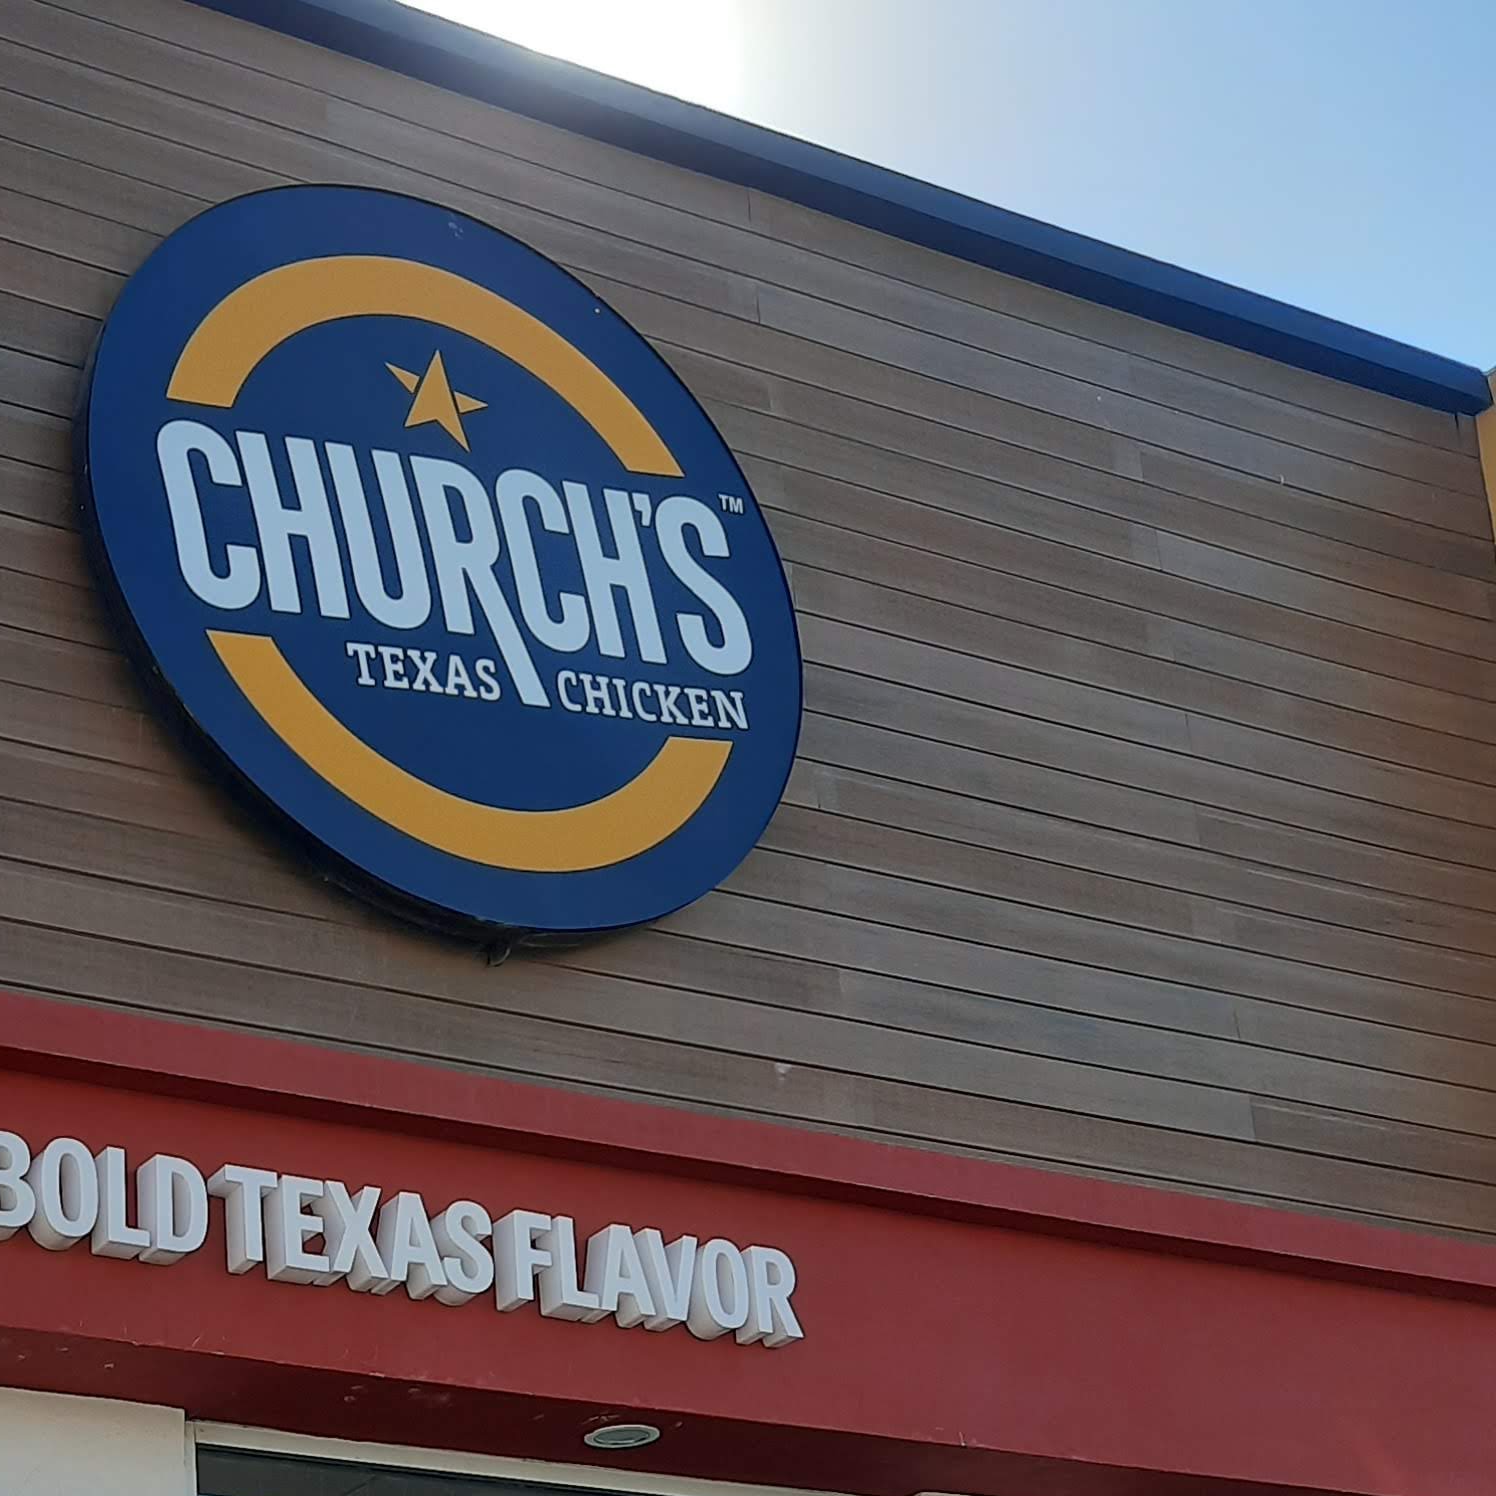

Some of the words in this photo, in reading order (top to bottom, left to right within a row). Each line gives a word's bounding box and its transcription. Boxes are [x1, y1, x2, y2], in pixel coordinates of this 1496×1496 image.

[156, 419, 753, 707] CHURCH'S
[346, 641, 502, 702] TEXAS
[556, 670, 749, 730] CHICKEN
[209, 1164, 494, 1306] TEXAS
[494, 1209, 805, 1347] FLAVOR
